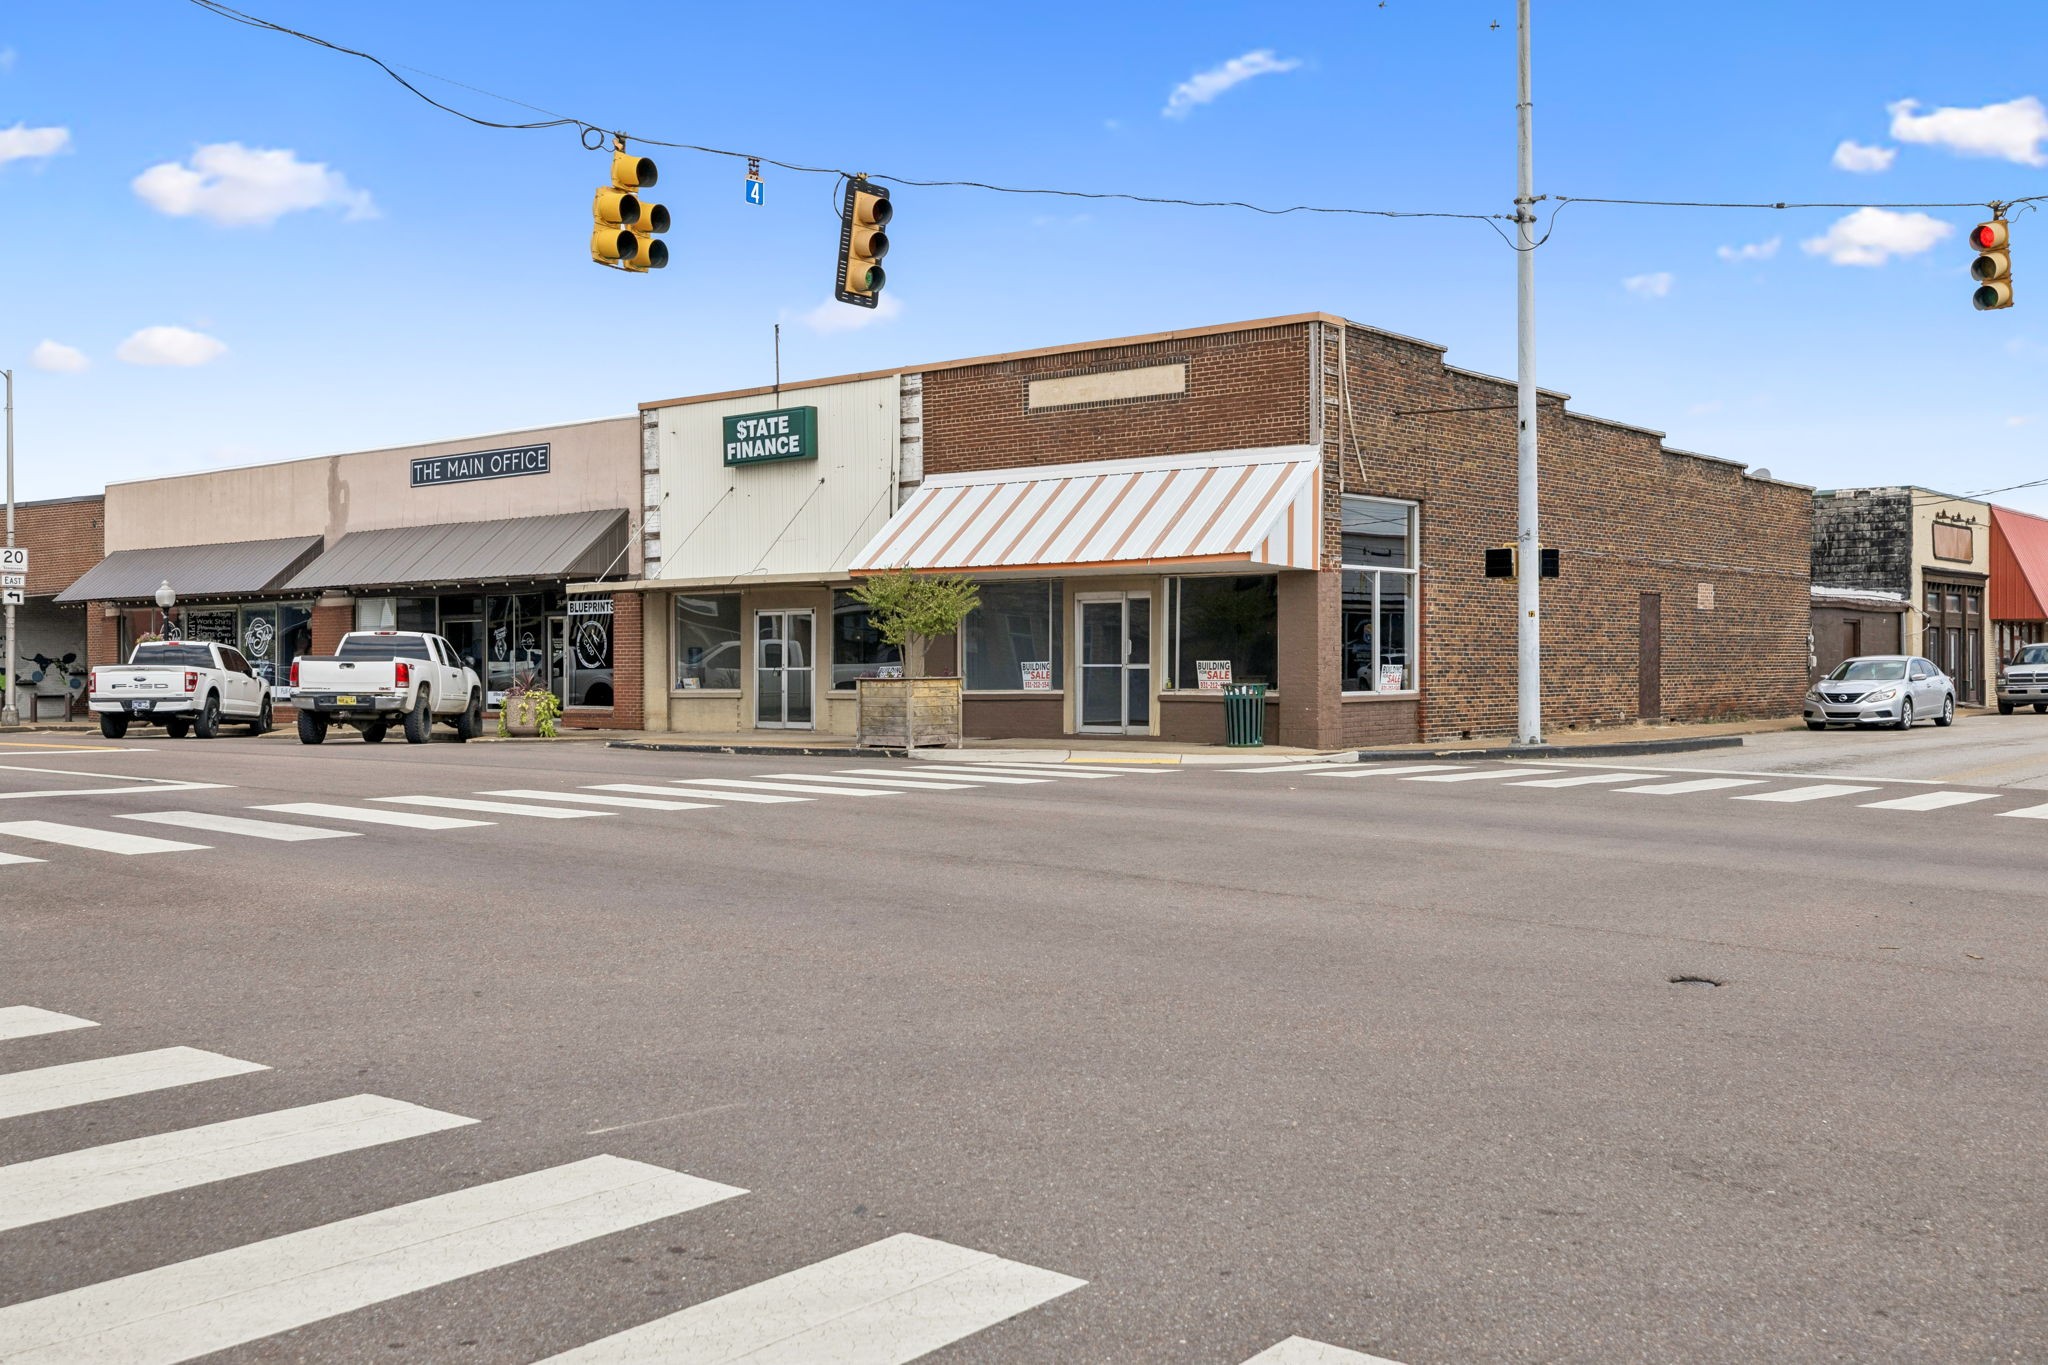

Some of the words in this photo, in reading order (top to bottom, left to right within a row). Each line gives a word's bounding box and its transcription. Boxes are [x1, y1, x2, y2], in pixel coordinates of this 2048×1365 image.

[751, 182, 760, 203] 4
[727, 435, 800, 460] FINANCE
[414, 462, 441, 481] THE
[447, 457, 484, 478] MAIN
[490, 449, 547, 472] OFFICE
[4, 550, 23, 563] 20
[570, 602, 613, 613] BLUEPRINTS
[1022, 662, 1050, 671] BUILDING
[1197, 661, 1230, 670] BUILDING
[1030, 670, 1050, 680] SALE
[1207, 670, 1230, 680] SALE
